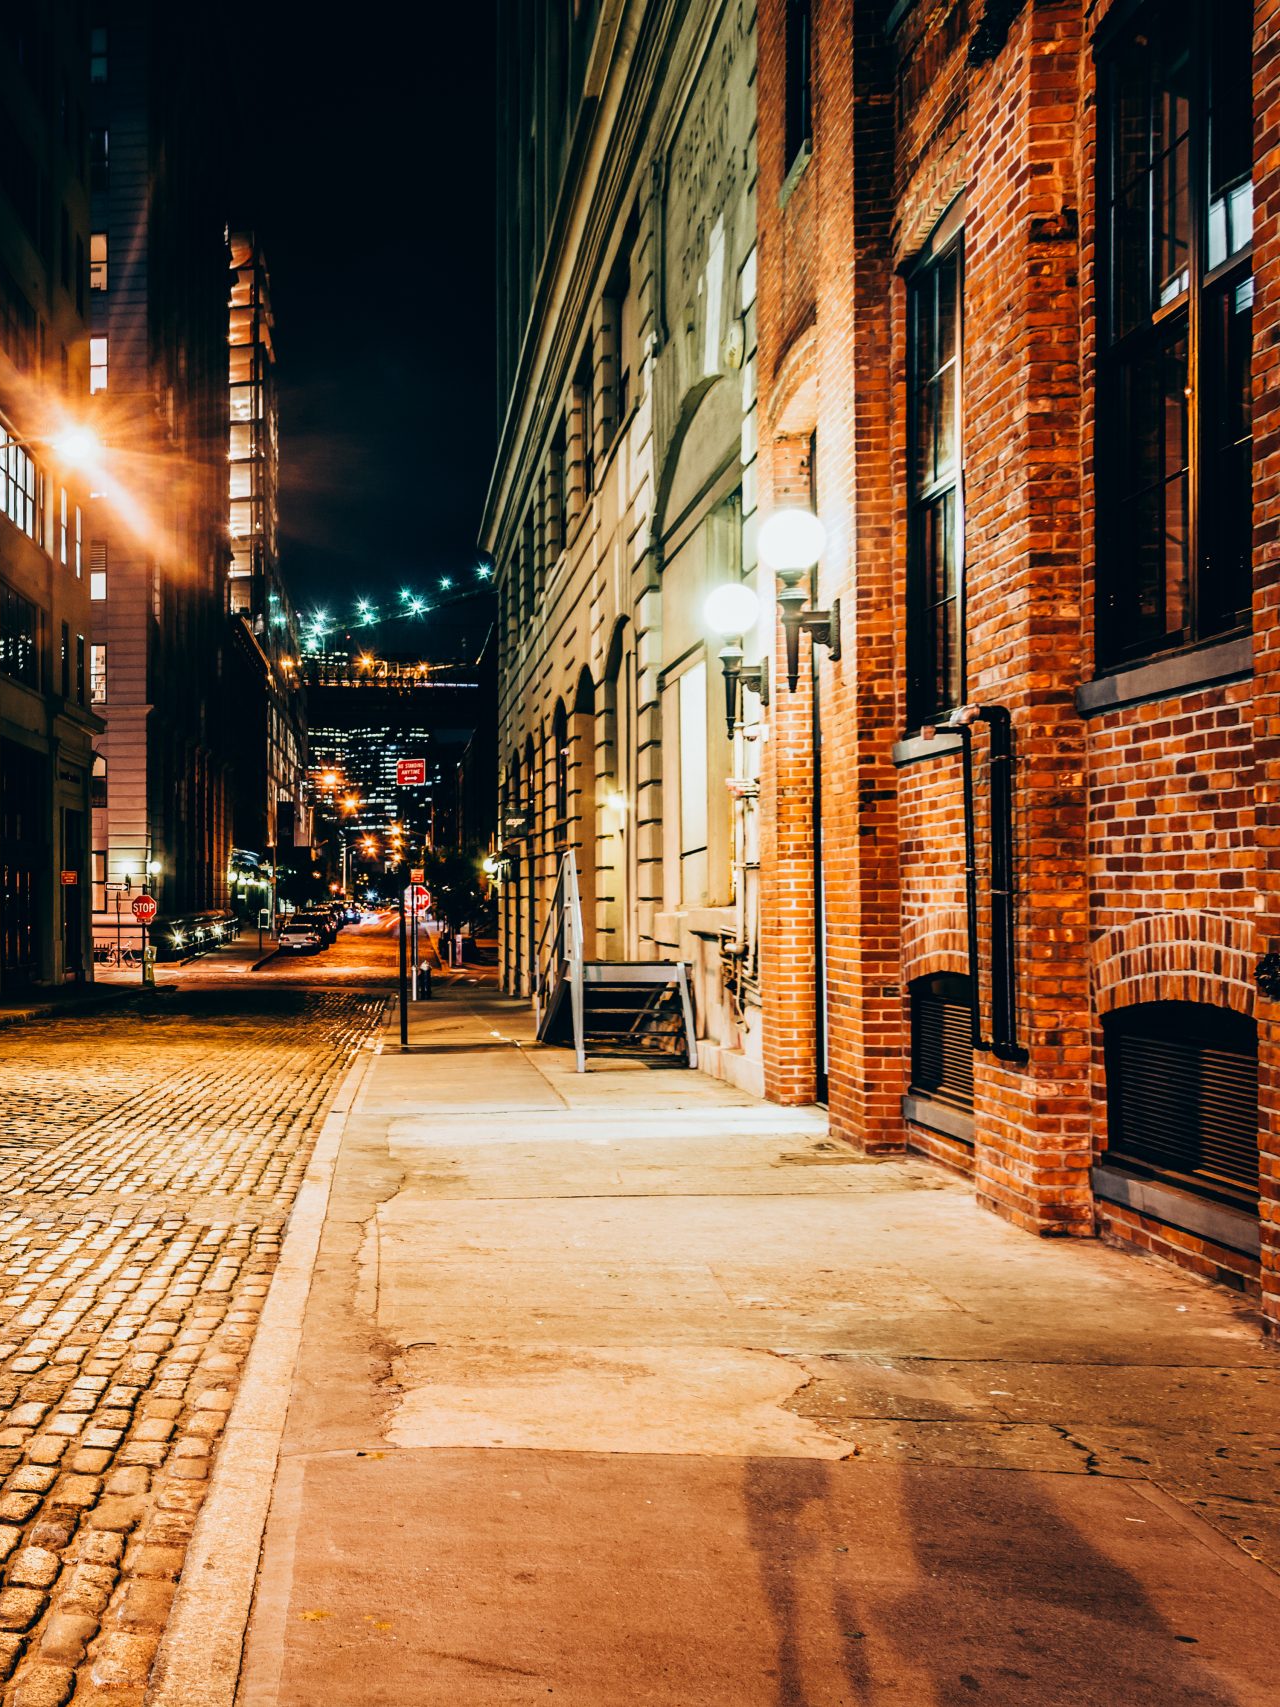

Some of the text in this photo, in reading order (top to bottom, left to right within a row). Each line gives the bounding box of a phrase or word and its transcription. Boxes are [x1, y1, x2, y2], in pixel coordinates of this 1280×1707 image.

[721, 0, 742, 92] GAIR
[404, 894, 429, 905] SOP
[132, 902, 155, 913] STOP
